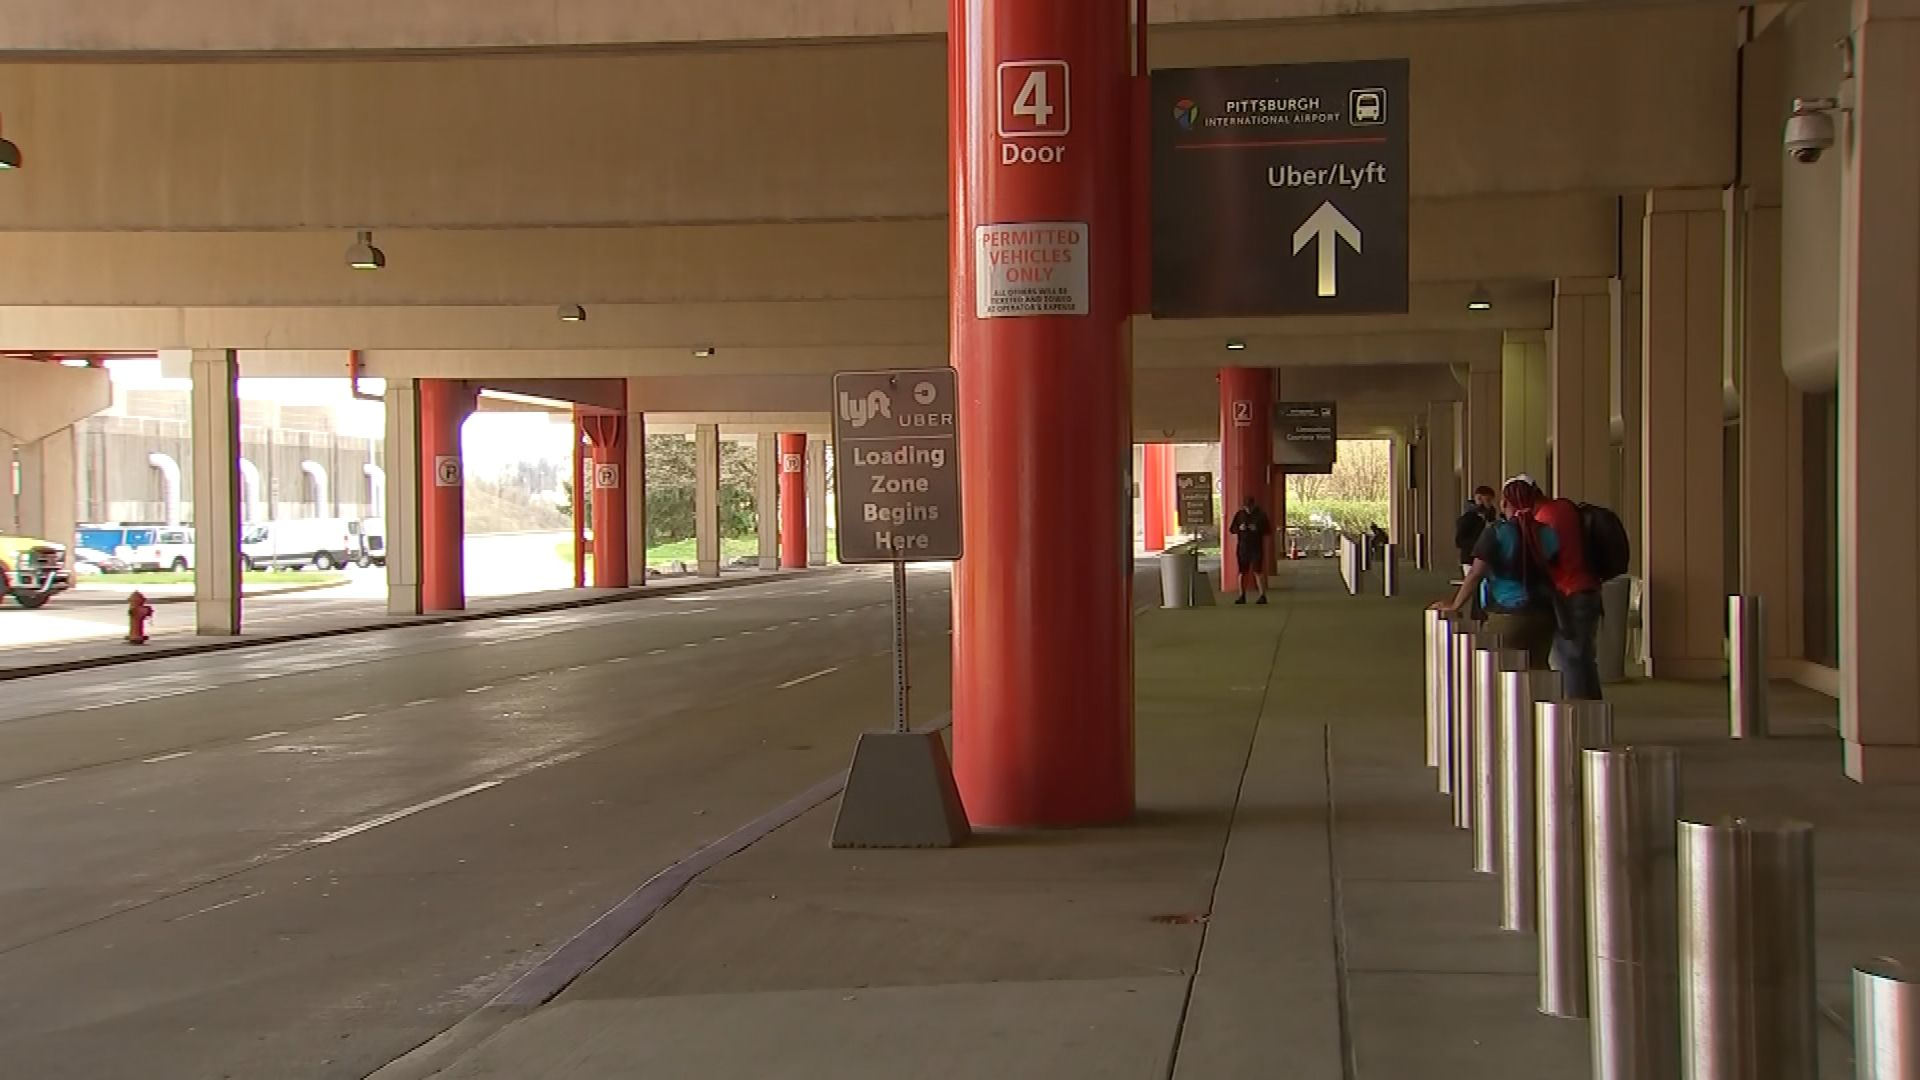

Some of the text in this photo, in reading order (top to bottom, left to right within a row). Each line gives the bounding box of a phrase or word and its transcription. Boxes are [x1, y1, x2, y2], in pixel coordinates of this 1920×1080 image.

[1013, 71, 1053, 125] 4
[1226, 97, 1320, 113] PITTSBURGH
[1205, 113, 1340, 127] INTERNATIONAL AIRPORT
[1002, 143, 1065, 165] Door
[1268, 161, 1387, 190] Uber/Lyft
[983, 229, 1080, 248] PERMITTED
[990, 248, 1072, 266] VEHICLES
[1006, 267, 1053, 283] ONLY
[1238, 404, 1247, 418] 2
[899, 414, 952, 427] UBER
[853, 446, 945, 468] Loading
[871, 475, 929, 493] Zone
[863, 502, 939, 524] Begins
[875, 531, 929, 550] Here
